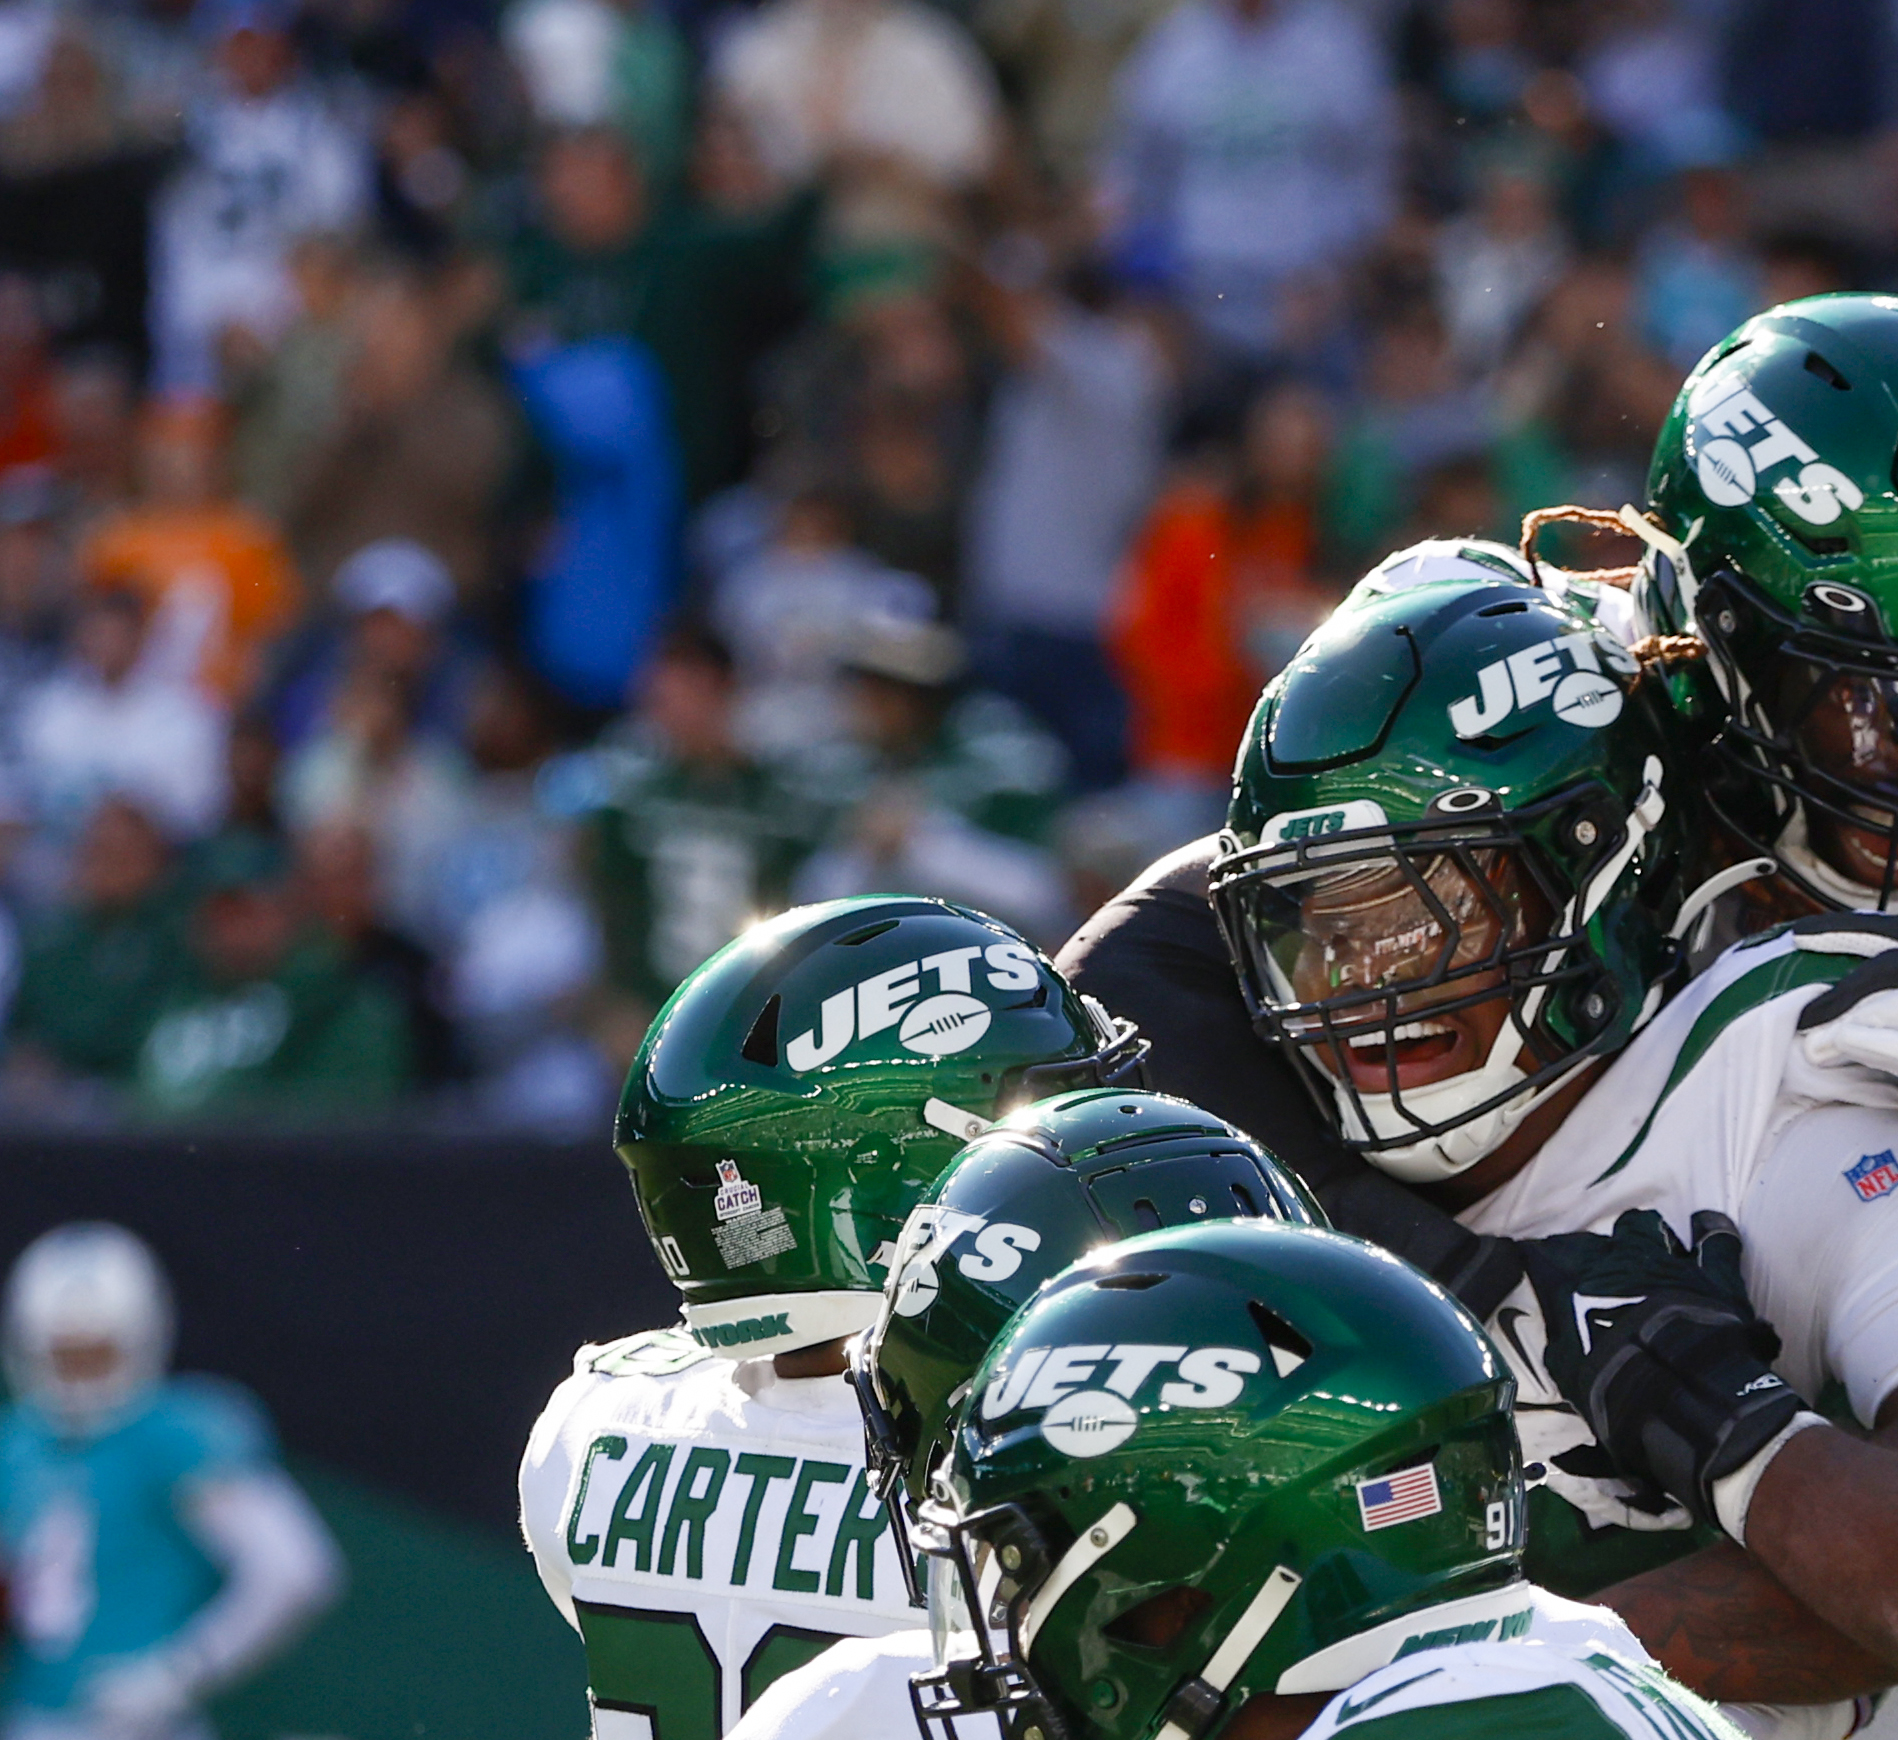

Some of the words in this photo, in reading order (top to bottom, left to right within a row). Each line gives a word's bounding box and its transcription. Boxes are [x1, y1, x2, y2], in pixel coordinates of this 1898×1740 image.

[1687, 370, 1865, 527] JETS
[1448, 630, 1642, 740] JETS
[1279, 810, 1346, 842] JETS
[786, 943, 1040, 1073] JETS
[717, 1187, 759, 1212] CATCH
[700, 1311, 794, 1349] YORK
[981, 1344, 1262, 1421] JETS
[566, 1435, 890, 1600] CARTER
